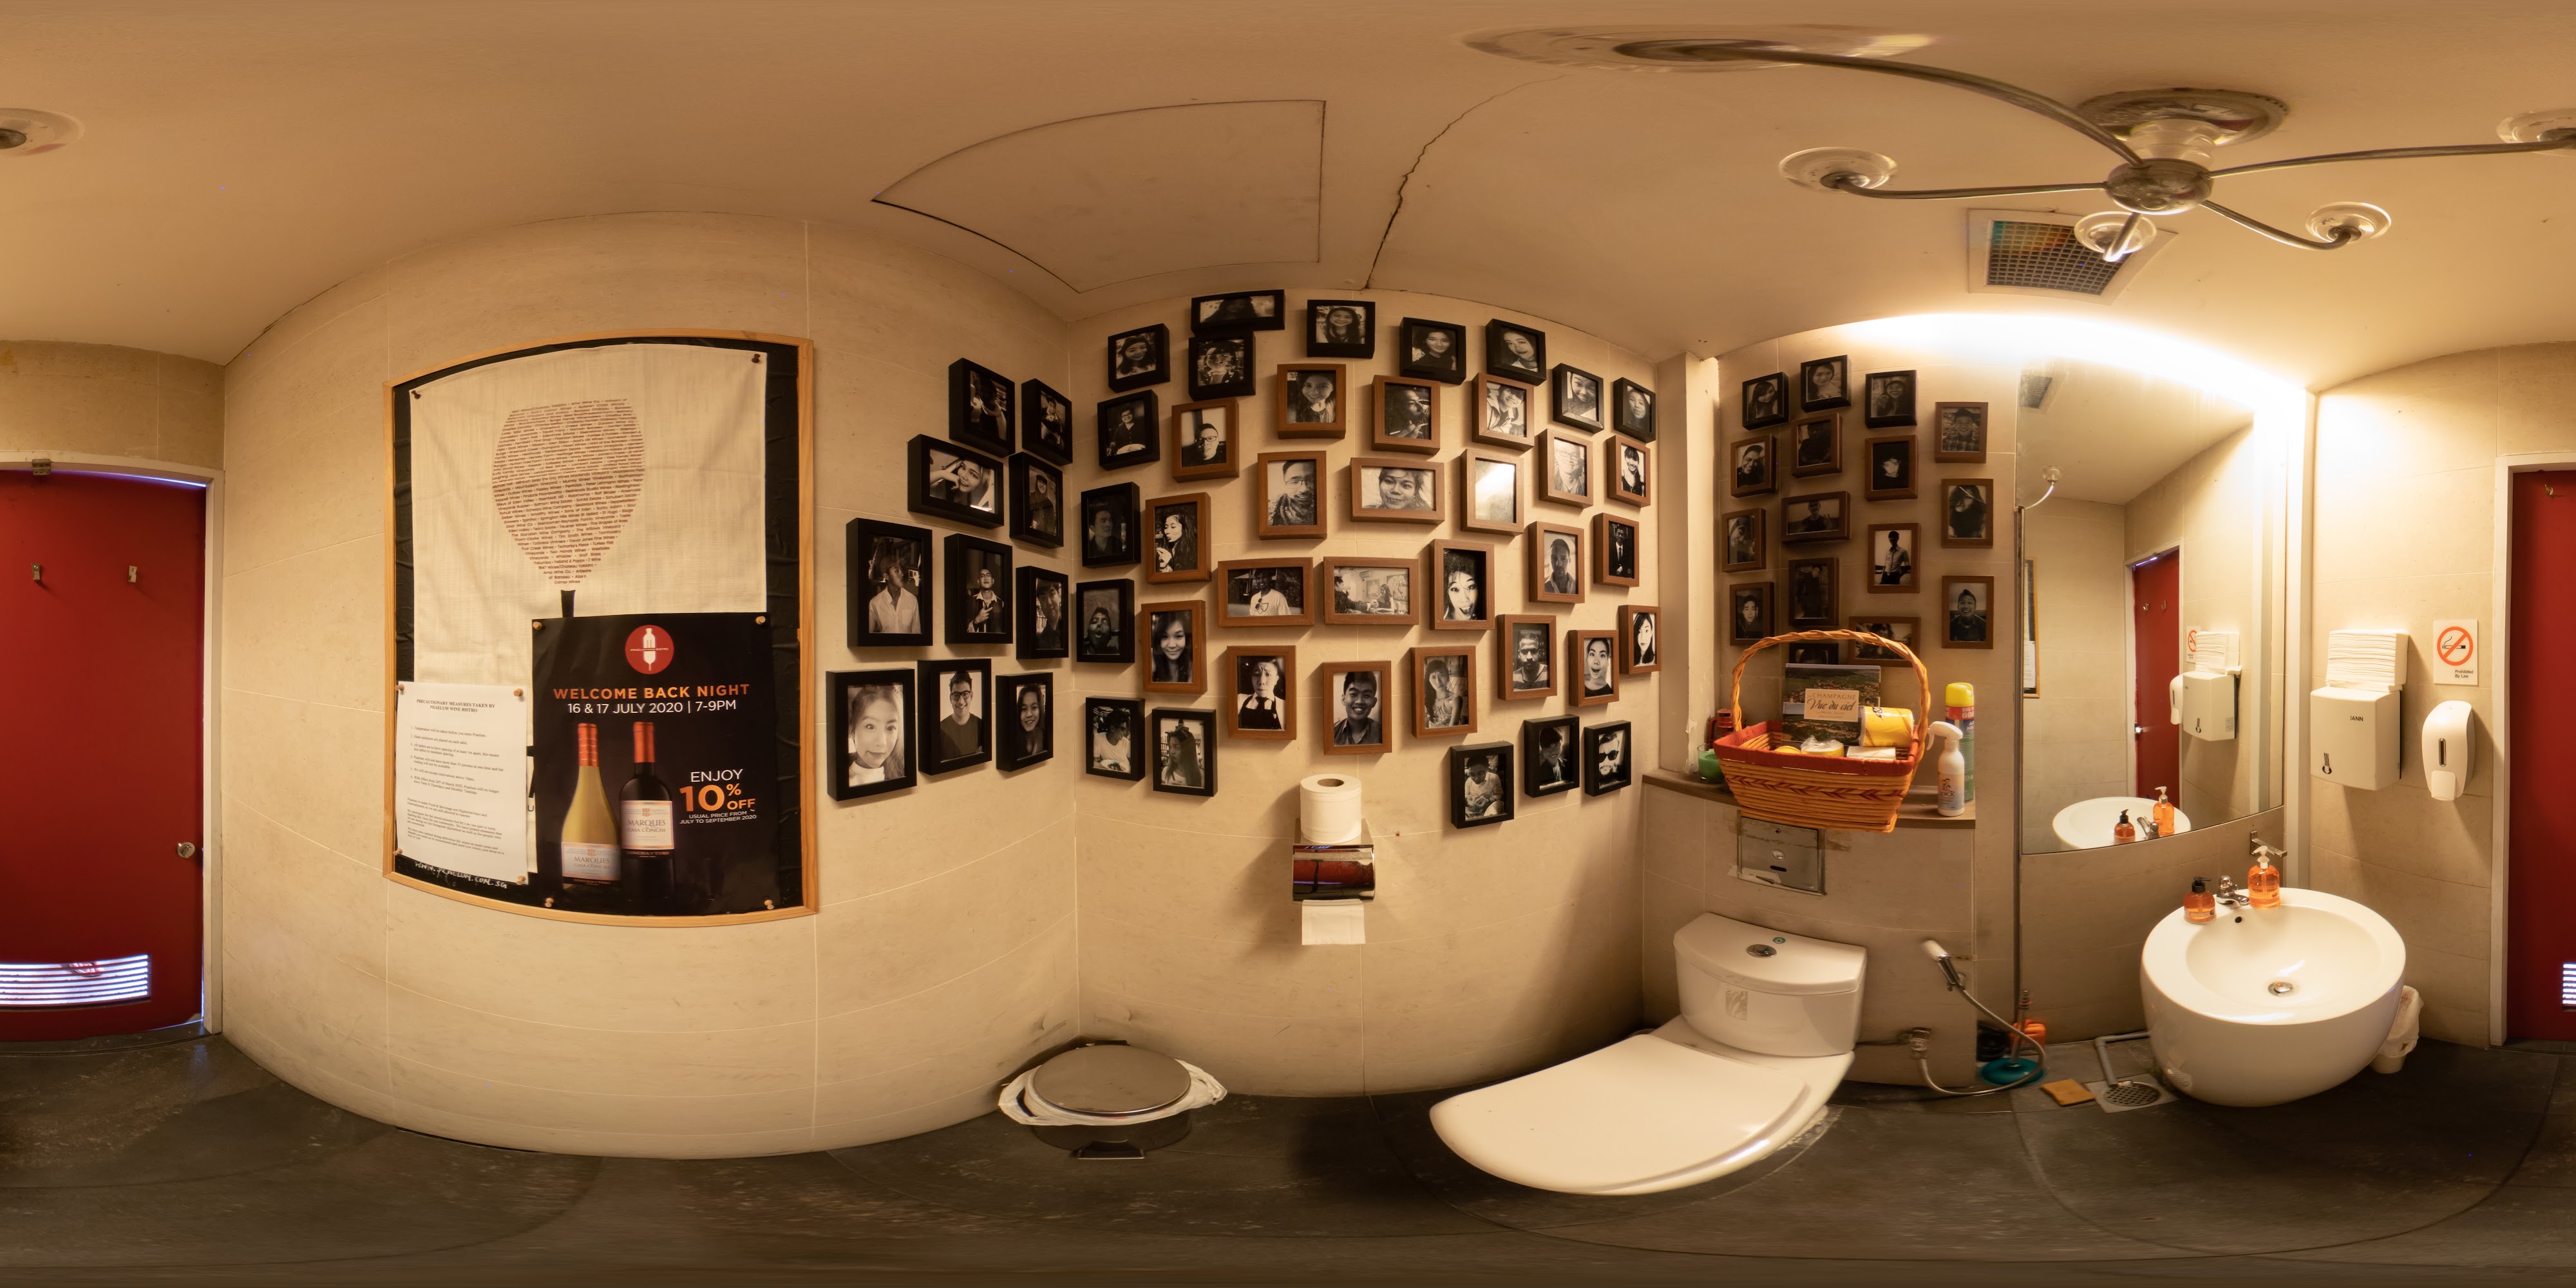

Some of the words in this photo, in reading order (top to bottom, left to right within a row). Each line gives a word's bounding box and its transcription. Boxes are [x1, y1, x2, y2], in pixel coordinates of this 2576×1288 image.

[553, 688, 637, 699] WELCOME
[644, 687, 690, 698] BACK
[697, 684, 749, 697] NIGHT
[568, 703, 581, 713] 16
[584, 703, 593, 714] &
[597, 703, 609, 714] 17
[613, 703, 645, 714] JULY
[649, 702, 683, 713] 2020
[696, 700, 736, 711] 7-9PM
[1807, 698, 1827, 710] Vue
[1829, 701, 1838, 710] du
[1841, 700, 1857, 711] ciel
[691, 769, 743, 782] ENJOY
[727, 799, 755, 810] OFF
